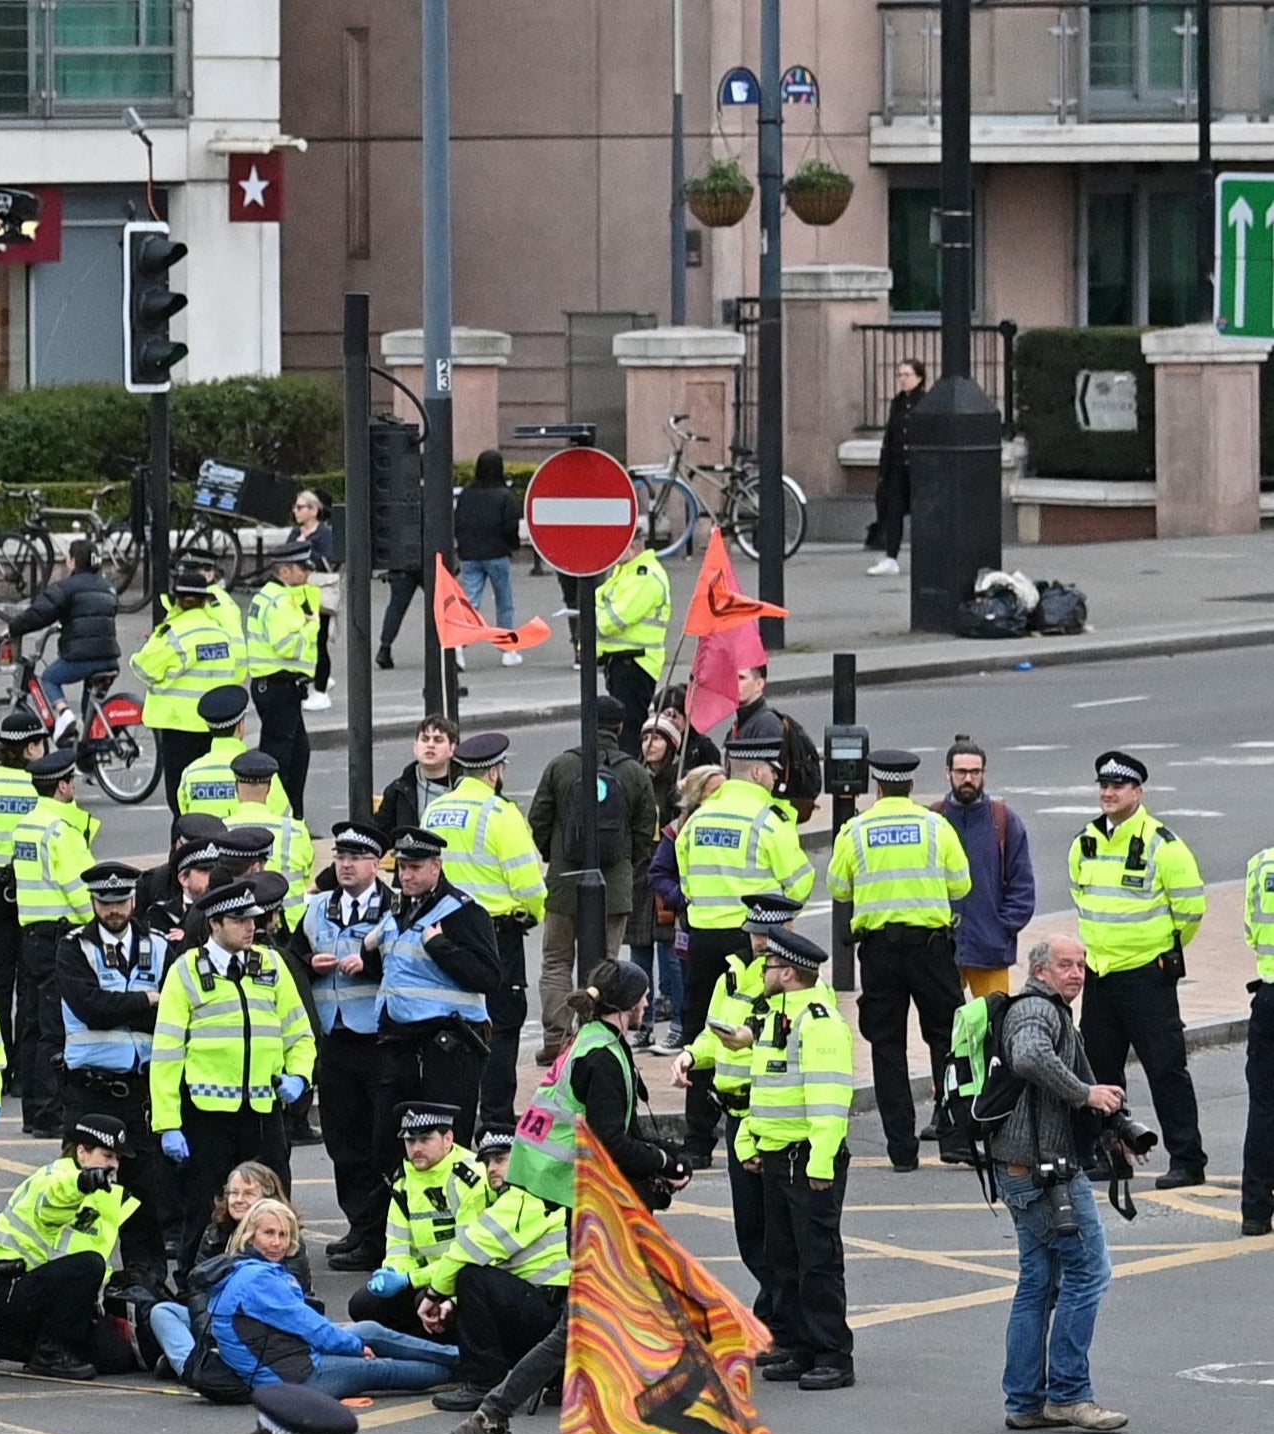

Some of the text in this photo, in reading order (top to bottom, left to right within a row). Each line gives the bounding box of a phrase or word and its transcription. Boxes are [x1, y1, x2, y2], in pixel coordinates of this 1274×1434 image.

[192, 786, 234, 800] POLICE
[697, 833, 740, 848] POLICE
[869, 831, 919, 846] POLICE
